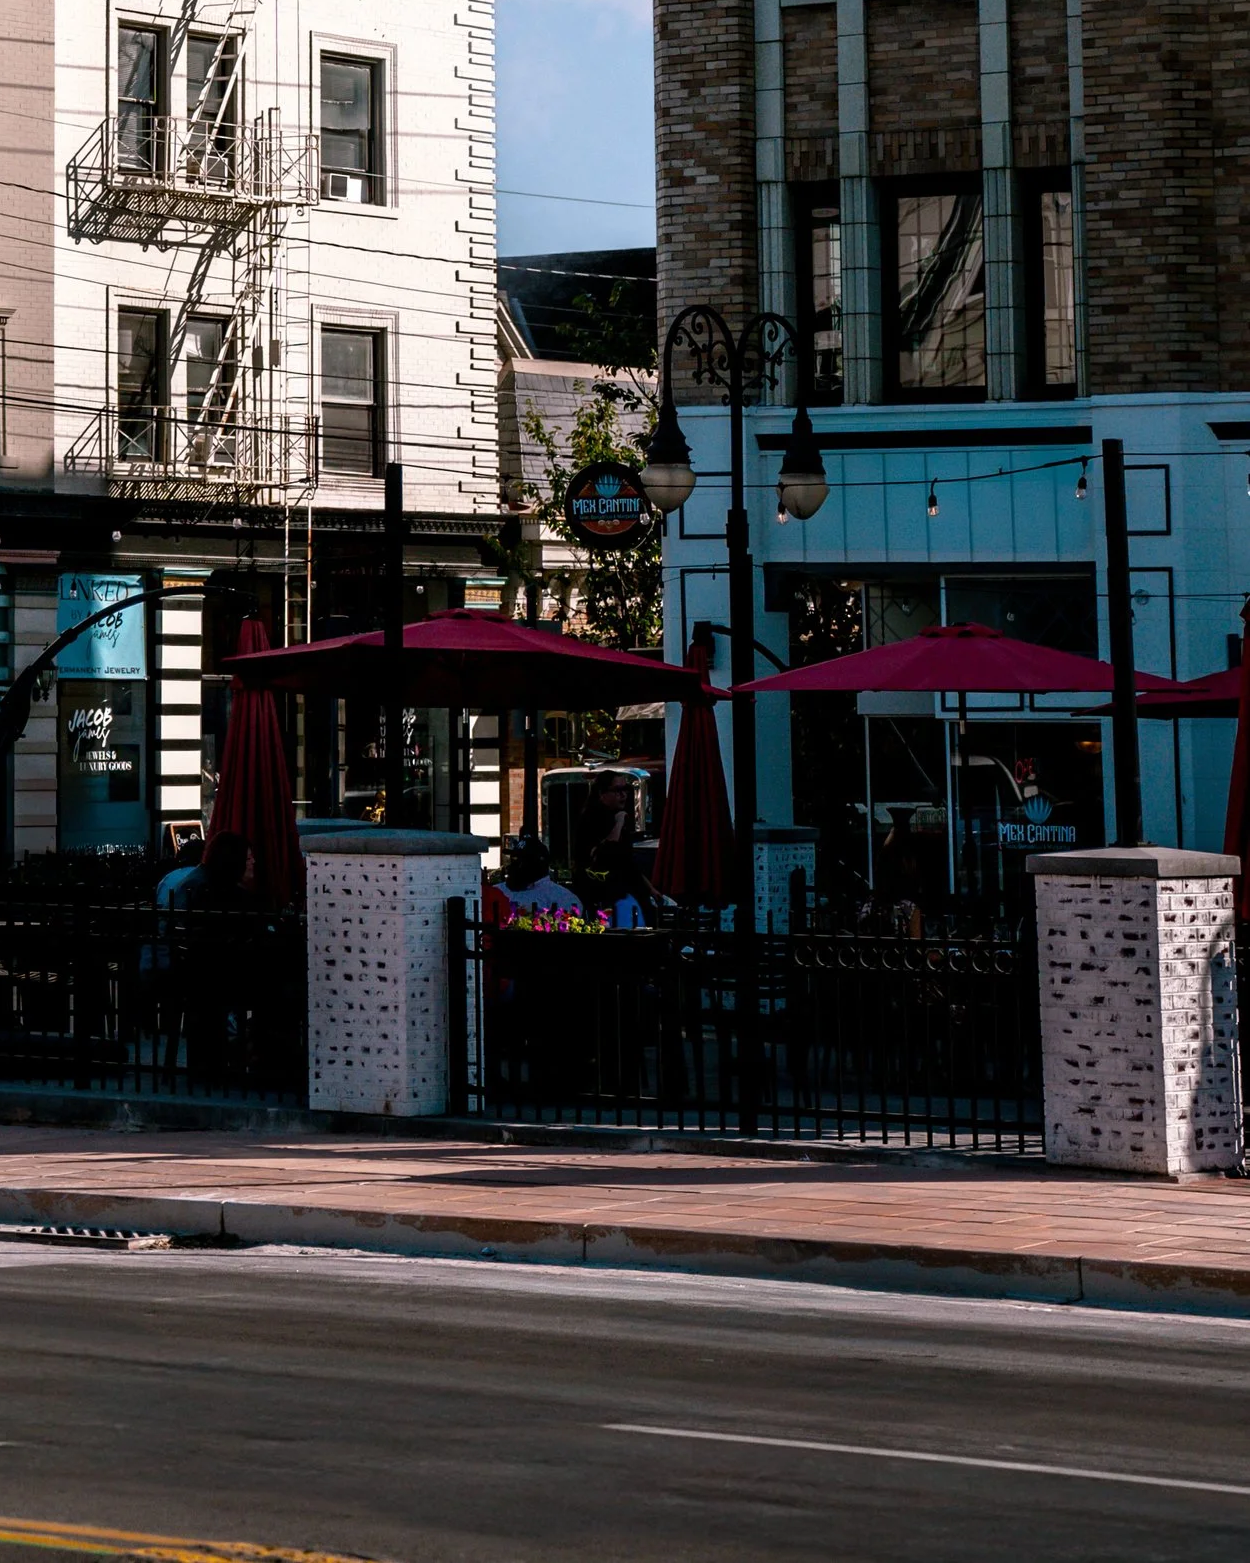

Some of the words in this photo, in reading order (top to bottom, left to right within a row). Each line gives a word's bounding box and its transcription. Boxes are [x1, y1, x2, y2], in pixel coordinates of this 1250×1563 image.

[572, 498, 597, 515] MEX
[60, 578, 129, 601] LNKED
[71, 609, 82, 620] BY
[59, 666, 101, 674] ERMANENT
[104, 666, 141, 674] JEWELRY
[68, 707, 113, 732] JACOB
[108, 760, 132, 771] GOODS
[998, 822, 1025, 842] MEX
[1027, 823, 1076, 843] CANTINA
